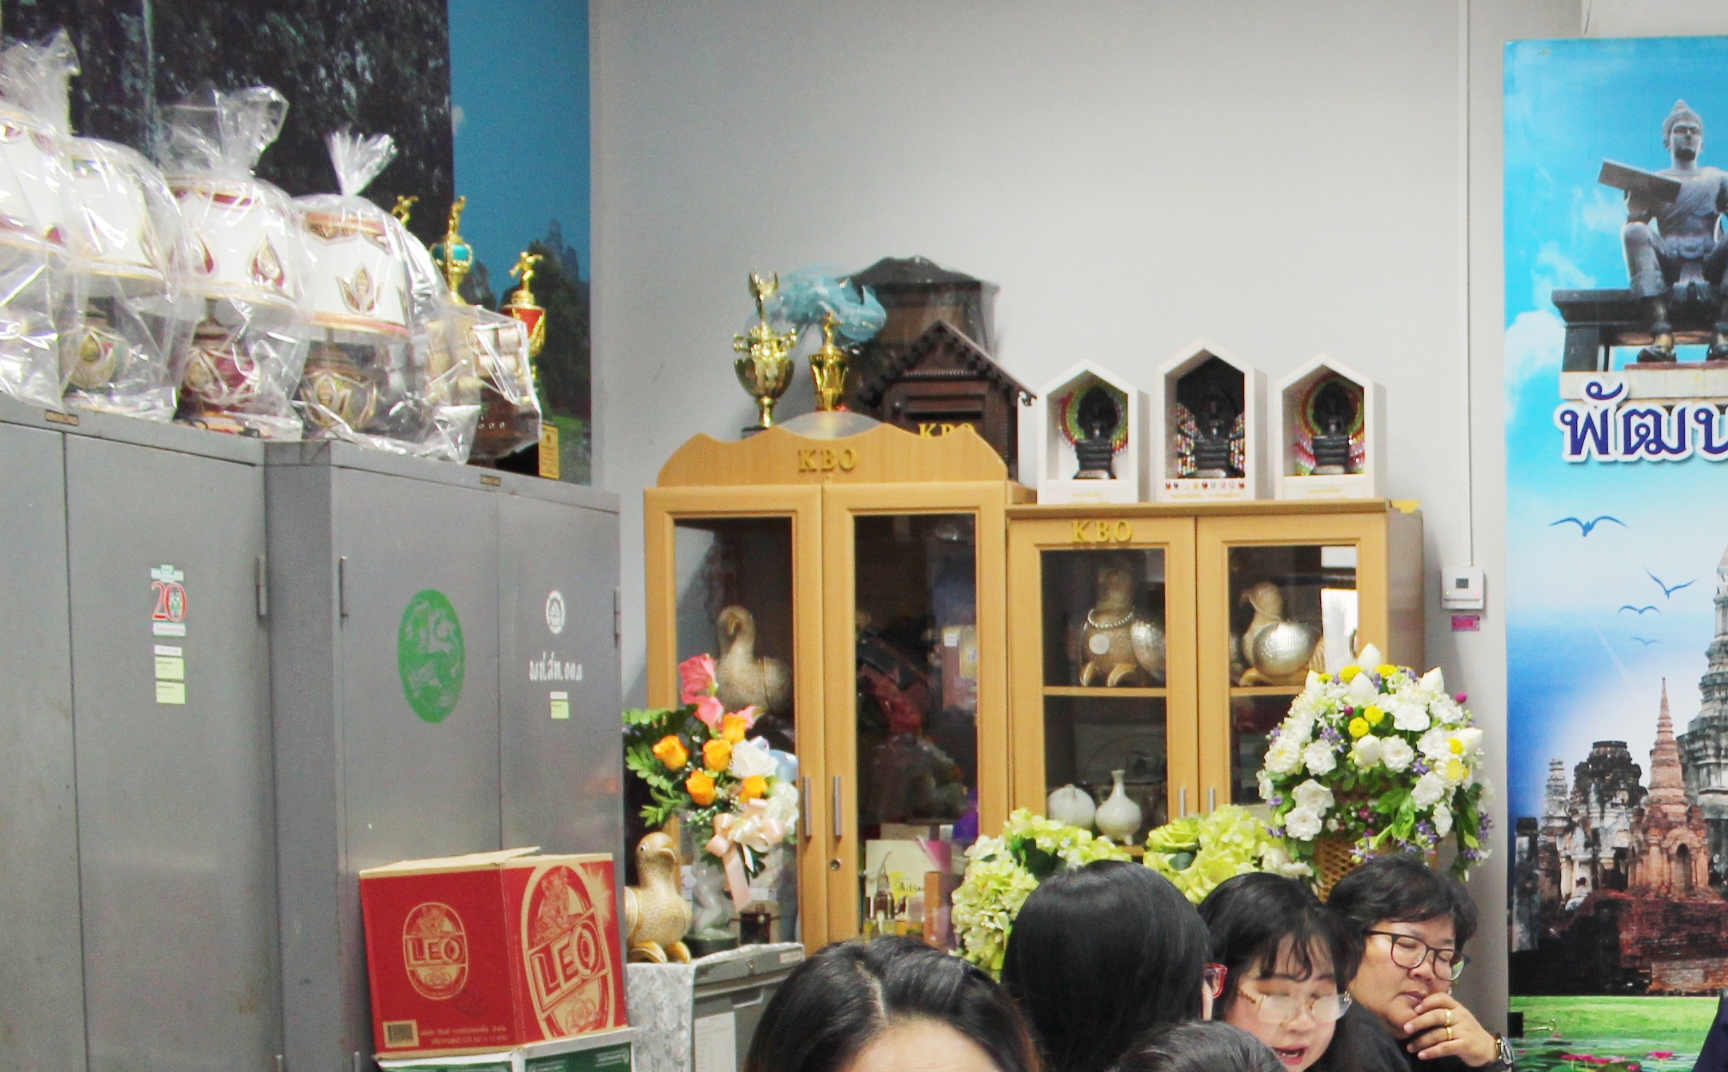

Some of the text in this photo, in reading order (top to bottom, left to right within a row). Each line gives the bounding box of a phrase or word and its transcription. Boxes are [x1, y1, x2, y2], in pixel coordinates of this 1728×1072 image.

[798, 448, 859, 473] KBO
[1071, 520, 1133, 544] KBO
[151, 581, 188, 622] 20
[407, 937, 463, 965] LEO
[530, 922, 600, 1011] LEO
